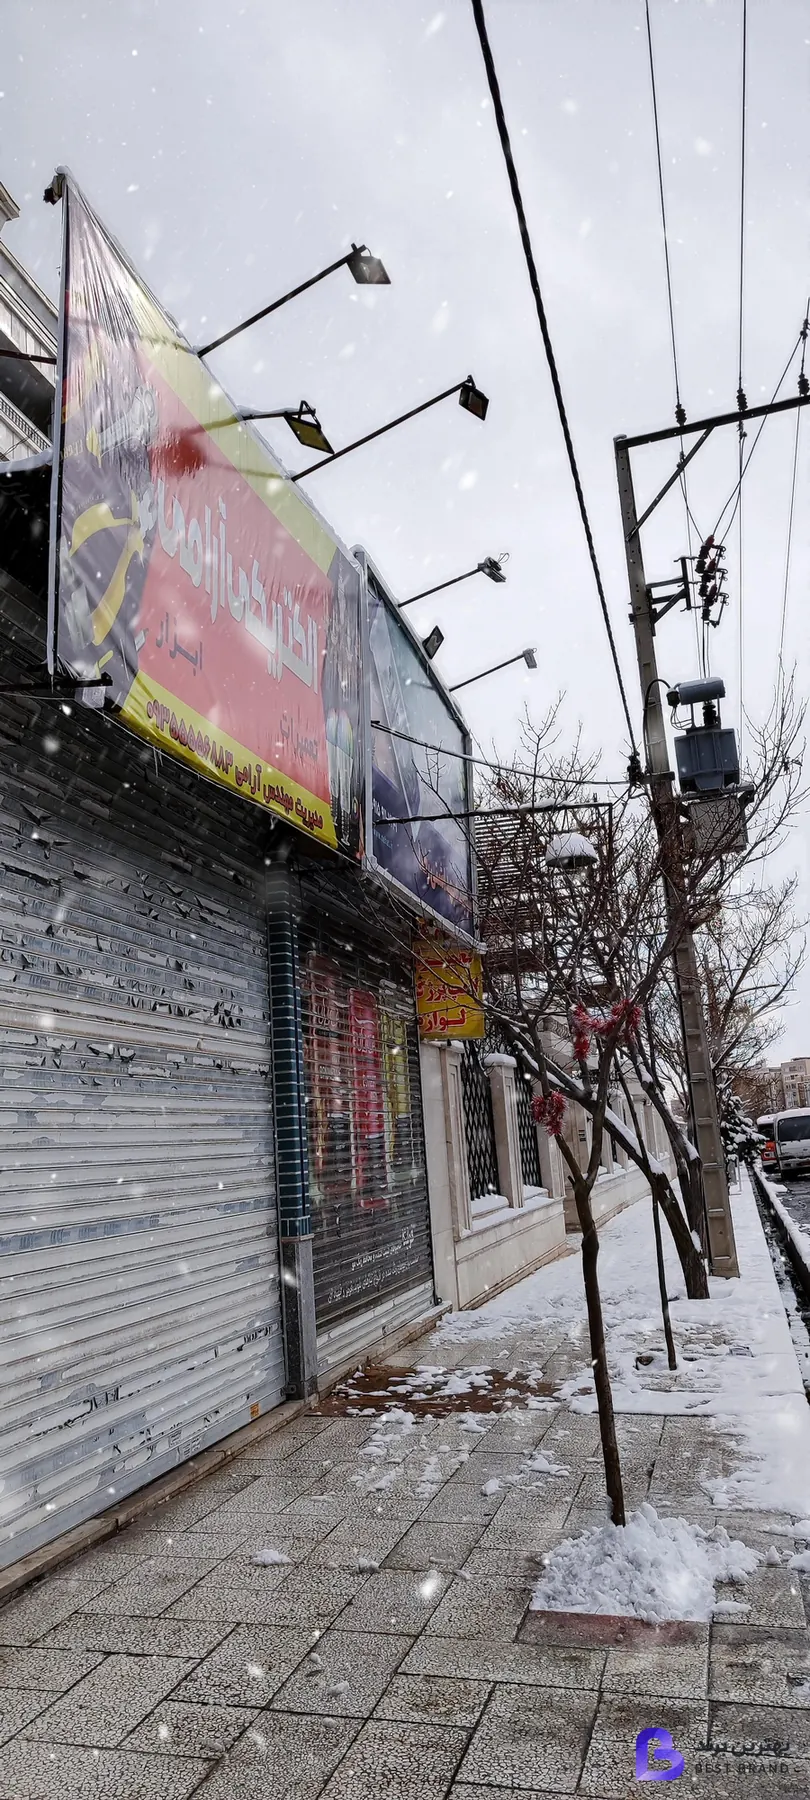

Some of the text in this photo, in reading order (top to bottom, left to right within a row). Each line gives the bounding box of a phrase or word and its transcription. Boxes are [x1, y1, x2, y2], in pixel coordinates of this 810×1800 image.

[226, 552, 318, 695] الکتریکی
[156, 611, 203, 677] ابزار
[234, 763, 262, 795] آرامی
[263, 783, 294, 815] مهندس
[295, 797, 324, 831] مدیریت
